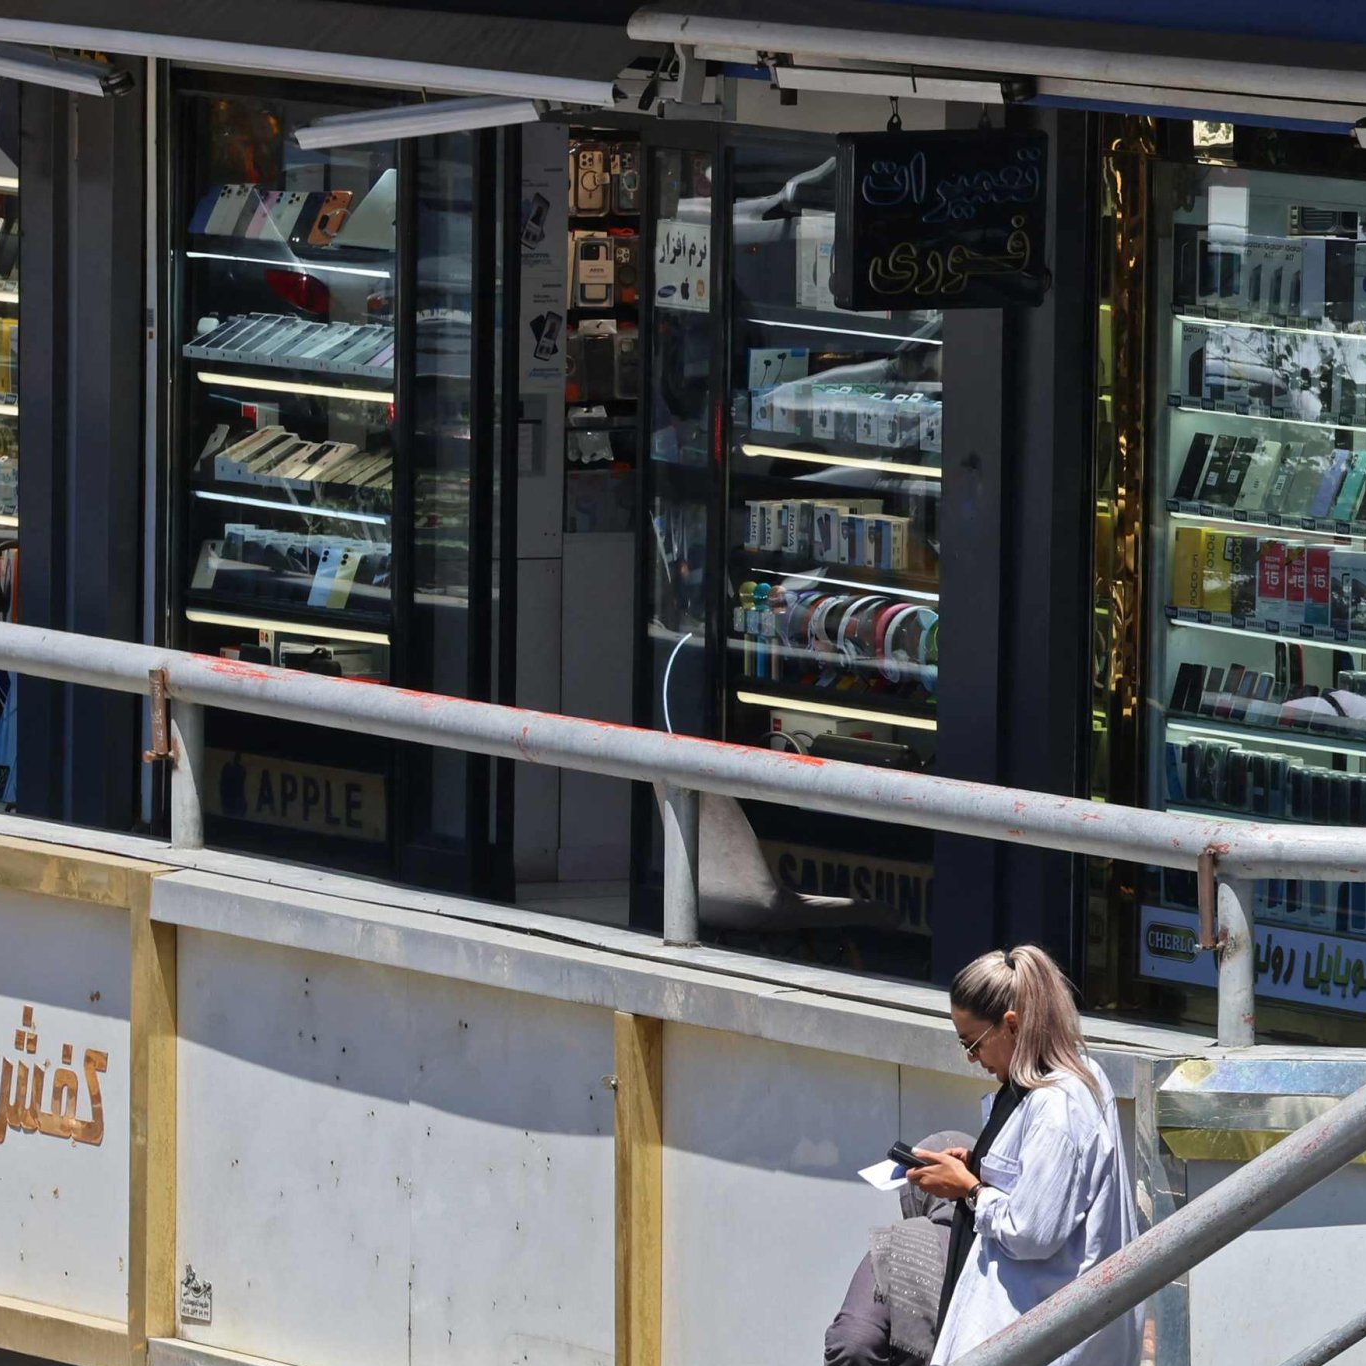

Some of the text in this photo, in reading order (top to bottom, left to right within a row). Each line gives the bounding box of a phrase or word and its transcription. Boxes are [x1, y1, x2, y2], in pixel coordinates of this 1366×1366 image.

[862, 150, 1041, 223] تعمیرات
[658, 232, 708, 268] نرم افزار
[869, 215, 1031, 294] فوری
[1206, 534, 1215, 569] POCO
[1234, 538, 1243, 573] POCO
[1189, 572, 1199, 606] POCO
[1264, 571, 1280, 585] 15
[1312, 574, 1326, 588] 15
[259, 772, 363, 828] APPLE
[1146, 930, 1198, 953] CHERLO
